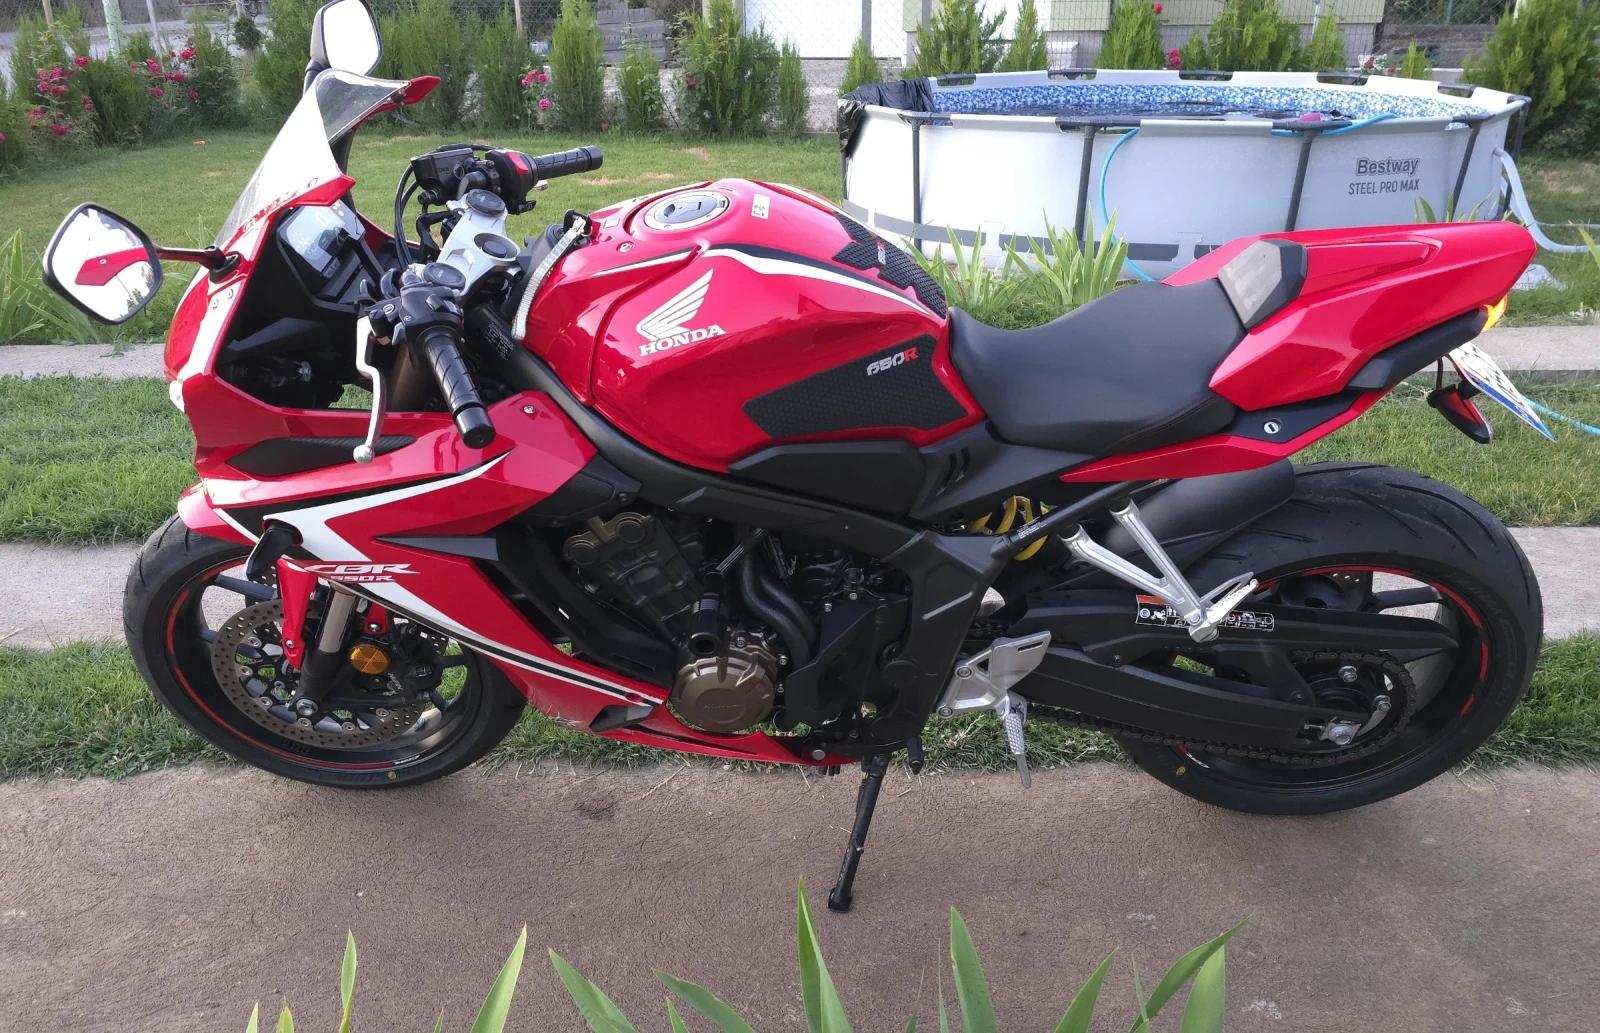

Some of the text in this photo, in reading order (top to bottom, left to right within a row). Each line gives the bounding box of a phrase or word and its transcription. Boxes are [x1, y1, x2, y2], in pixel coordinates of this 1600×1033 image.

[1356, 157, 1420, 177] Bestway
[1349, 179, 1420, 195] STEEL PRO MAX
[639, 324, 727, 357] HONDA
[866, 347, 919, 376] 650R
[303, 564, 421, 574] CBR
